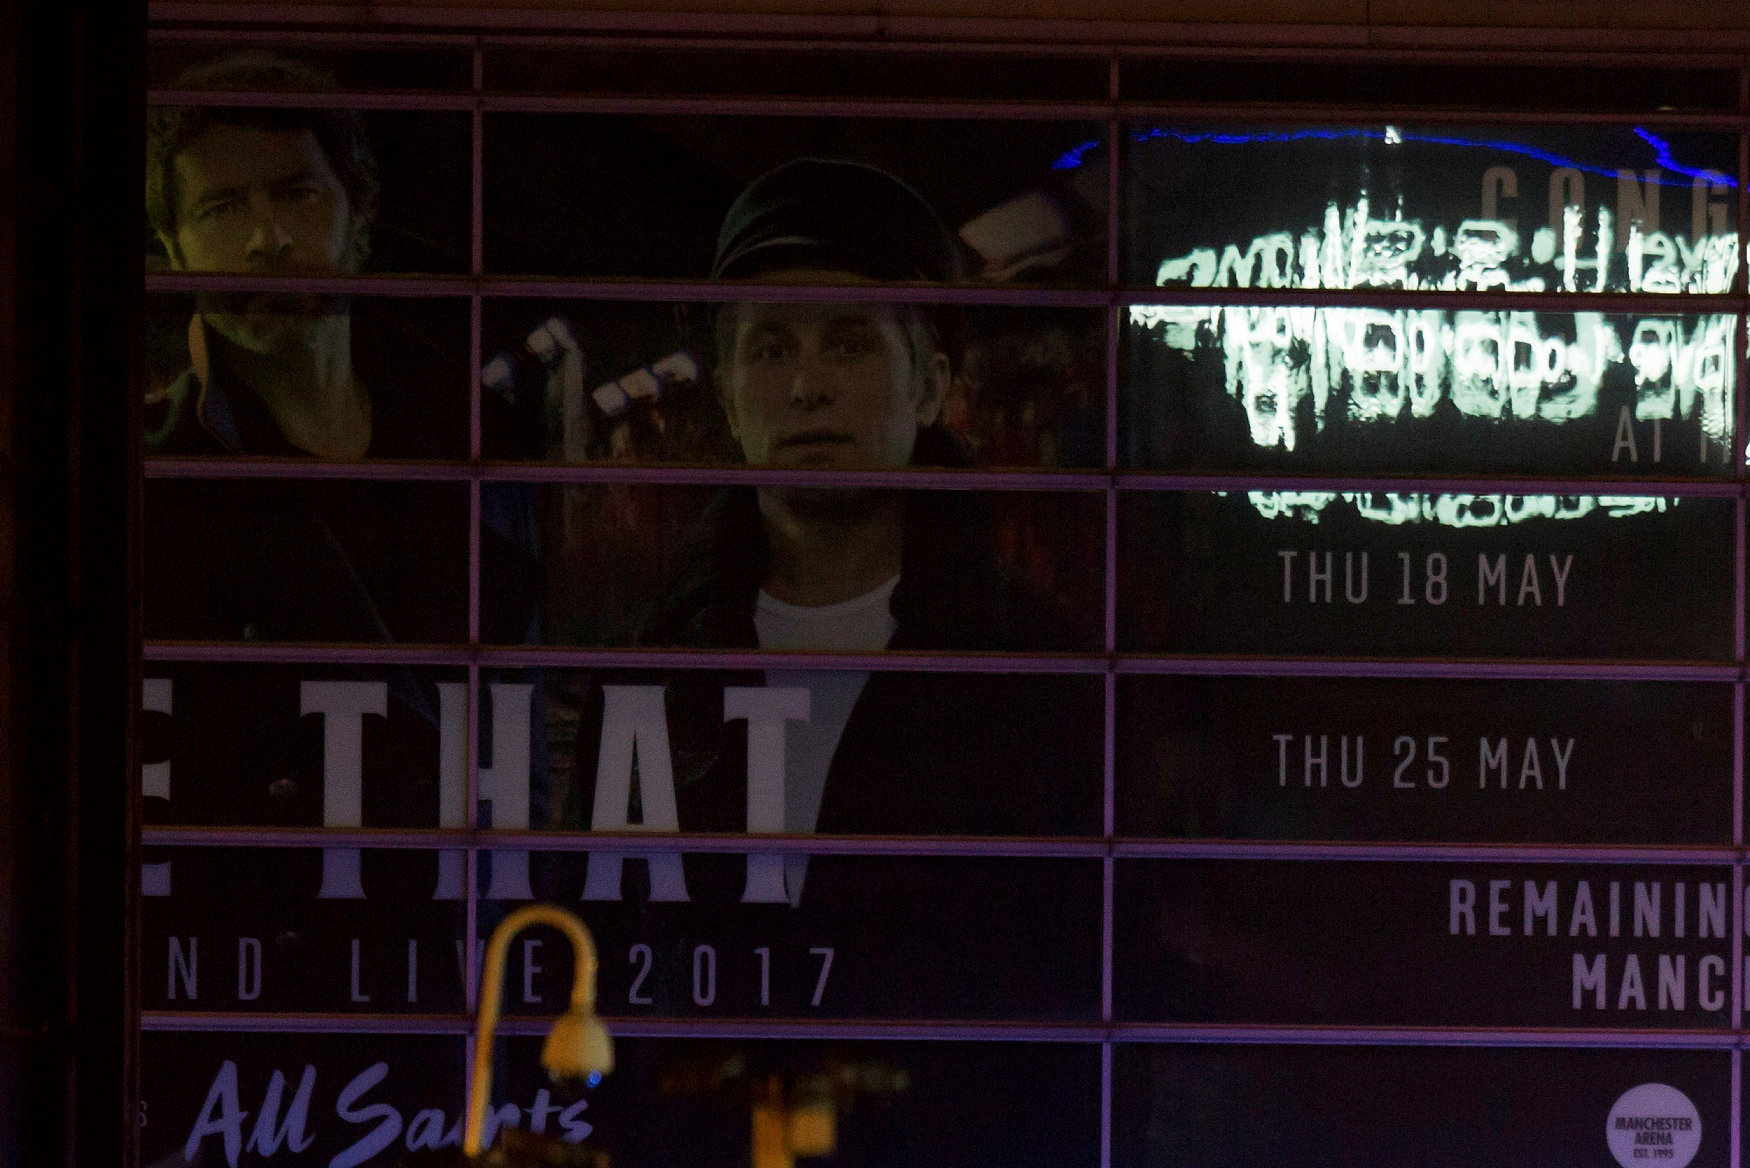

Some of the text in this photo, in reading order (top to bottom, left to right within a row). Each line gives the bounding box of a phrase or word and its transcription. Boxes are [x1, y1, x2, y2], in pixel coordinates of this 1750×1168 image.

[1277, 549, 1576, 607] THU 18 MAY
[1272, 733, 1577, 791] THU 25 MAY
[300, 679, 812, 908] THAT
[628, 943, 836, 1007] 2017
[1614, 1117, 1693, 1132] MANCHESTER
[1634, 1131, 1674, 1147] ARENA
